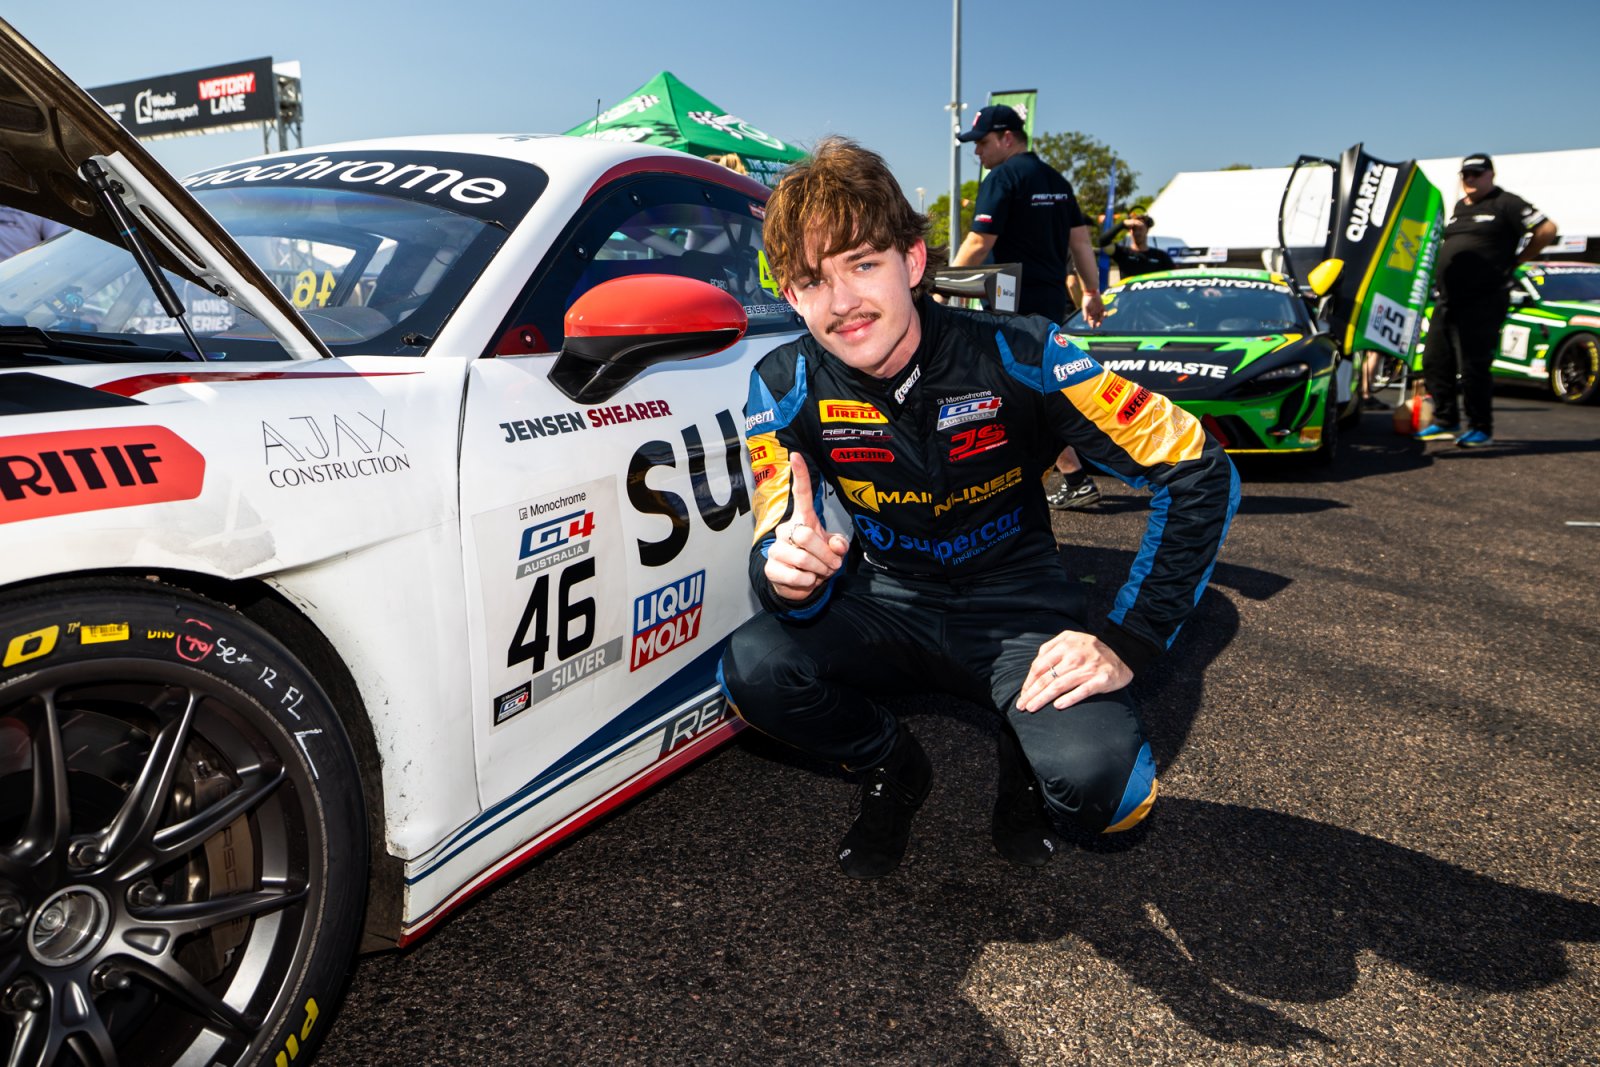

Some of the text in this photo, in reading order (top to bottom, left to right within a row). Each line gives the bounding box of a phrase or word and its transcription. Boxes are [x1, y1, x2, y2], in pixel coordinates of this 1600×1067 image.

[200, 74, 255, 98] VICTORY
[211, 94, 246, 115] LANE
[1346, 161, 1385, 242] QUARTZ
[1131, 278, 1291, 294] Monochrome
[744, 305, 769, 315] ENSEN
[1381, 306, 1405, 346] 25
[894, 364, 921, 405] freem
[1053, 358, 1094, 382] freem
[1104, 360, 1228, 379] WM WASTE
[827, 405, 881, 419] PIRELLI
[946, 390, 992, 404] Monochrome
[262, 409, 405, 465] AJAX
[499, 400, 673, 444] JENSEN SHEARER
[269, 454, 411, 488] CONSTRUCTION
[839, 451, 888, 460] APERITIF
[0, 443, 163, 501] RITIF
[626, 408, 751, 567] su
[530, 492, 587, 518] Monochrome
[524, 545, 584, 574] AUSTRALIA
[507, 556, 596, 675] 46
[637, 573, 702, 632] LIQUI
[634, 607, 701, 668] MOLY
[258, 666, 275, 689] 12
[551, 648, 607, 691] SILVER
